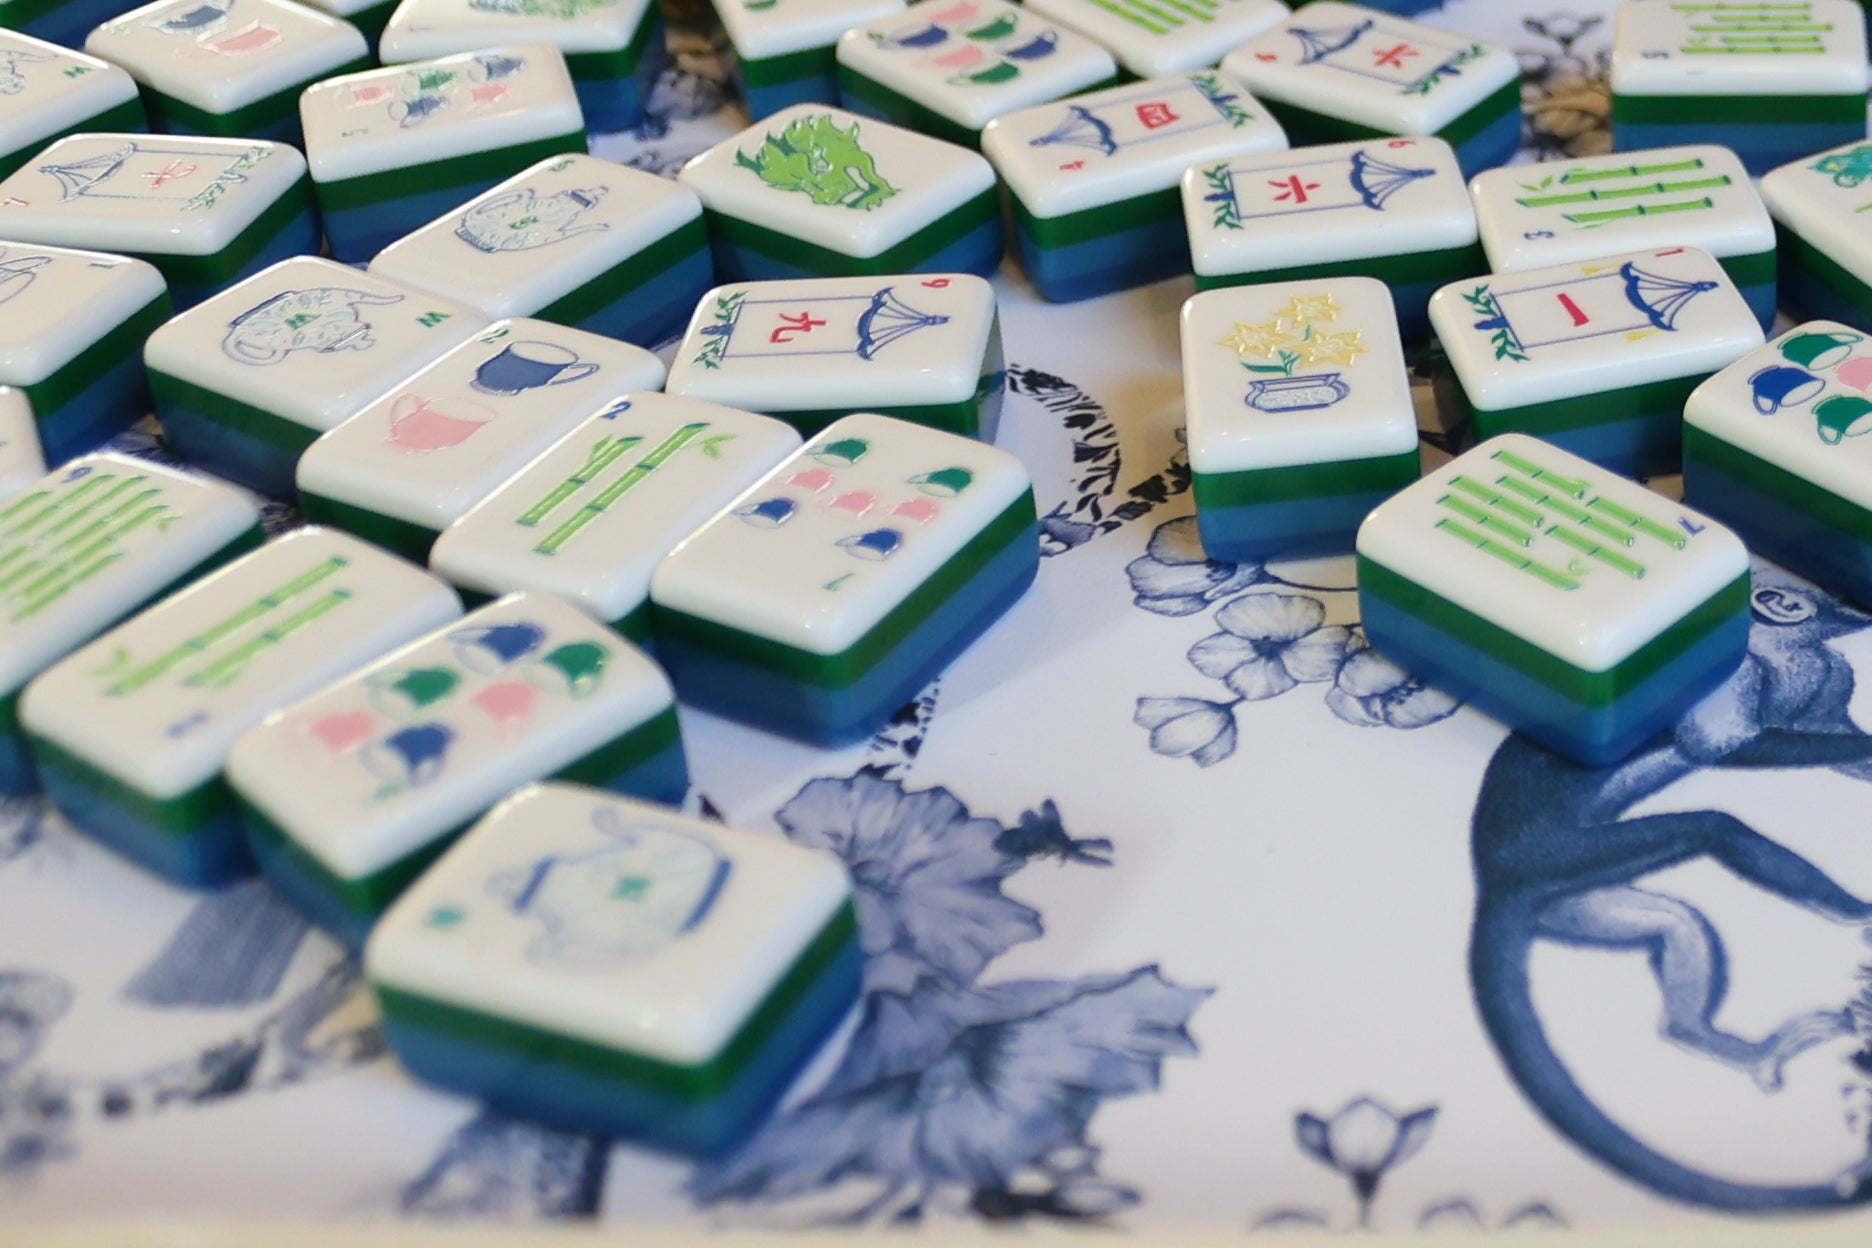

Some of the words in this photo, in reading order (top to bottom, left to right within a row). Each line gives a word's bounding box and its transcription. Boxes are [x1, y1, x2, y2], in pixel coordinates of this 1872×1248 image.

[1372, 43, 1420, 69] 六
[1135, 102, 1181, 130] 四
[1387, 139, 1417, 149] 6
[142, 157, 198, 188] 七
[1267, 174, 1322, 204] 六
[1522, 230, 1556, 241] 3
[920, 278, 952, 289] 9
[284, 312, 322, 330] W
[415, 311, 453, 328] W
[769, 310, 828, 343] 九
[479, 327, 510, 344] 2
[599, 400, 633, 420] 2
[1678, 517, 1706, 536] 7
